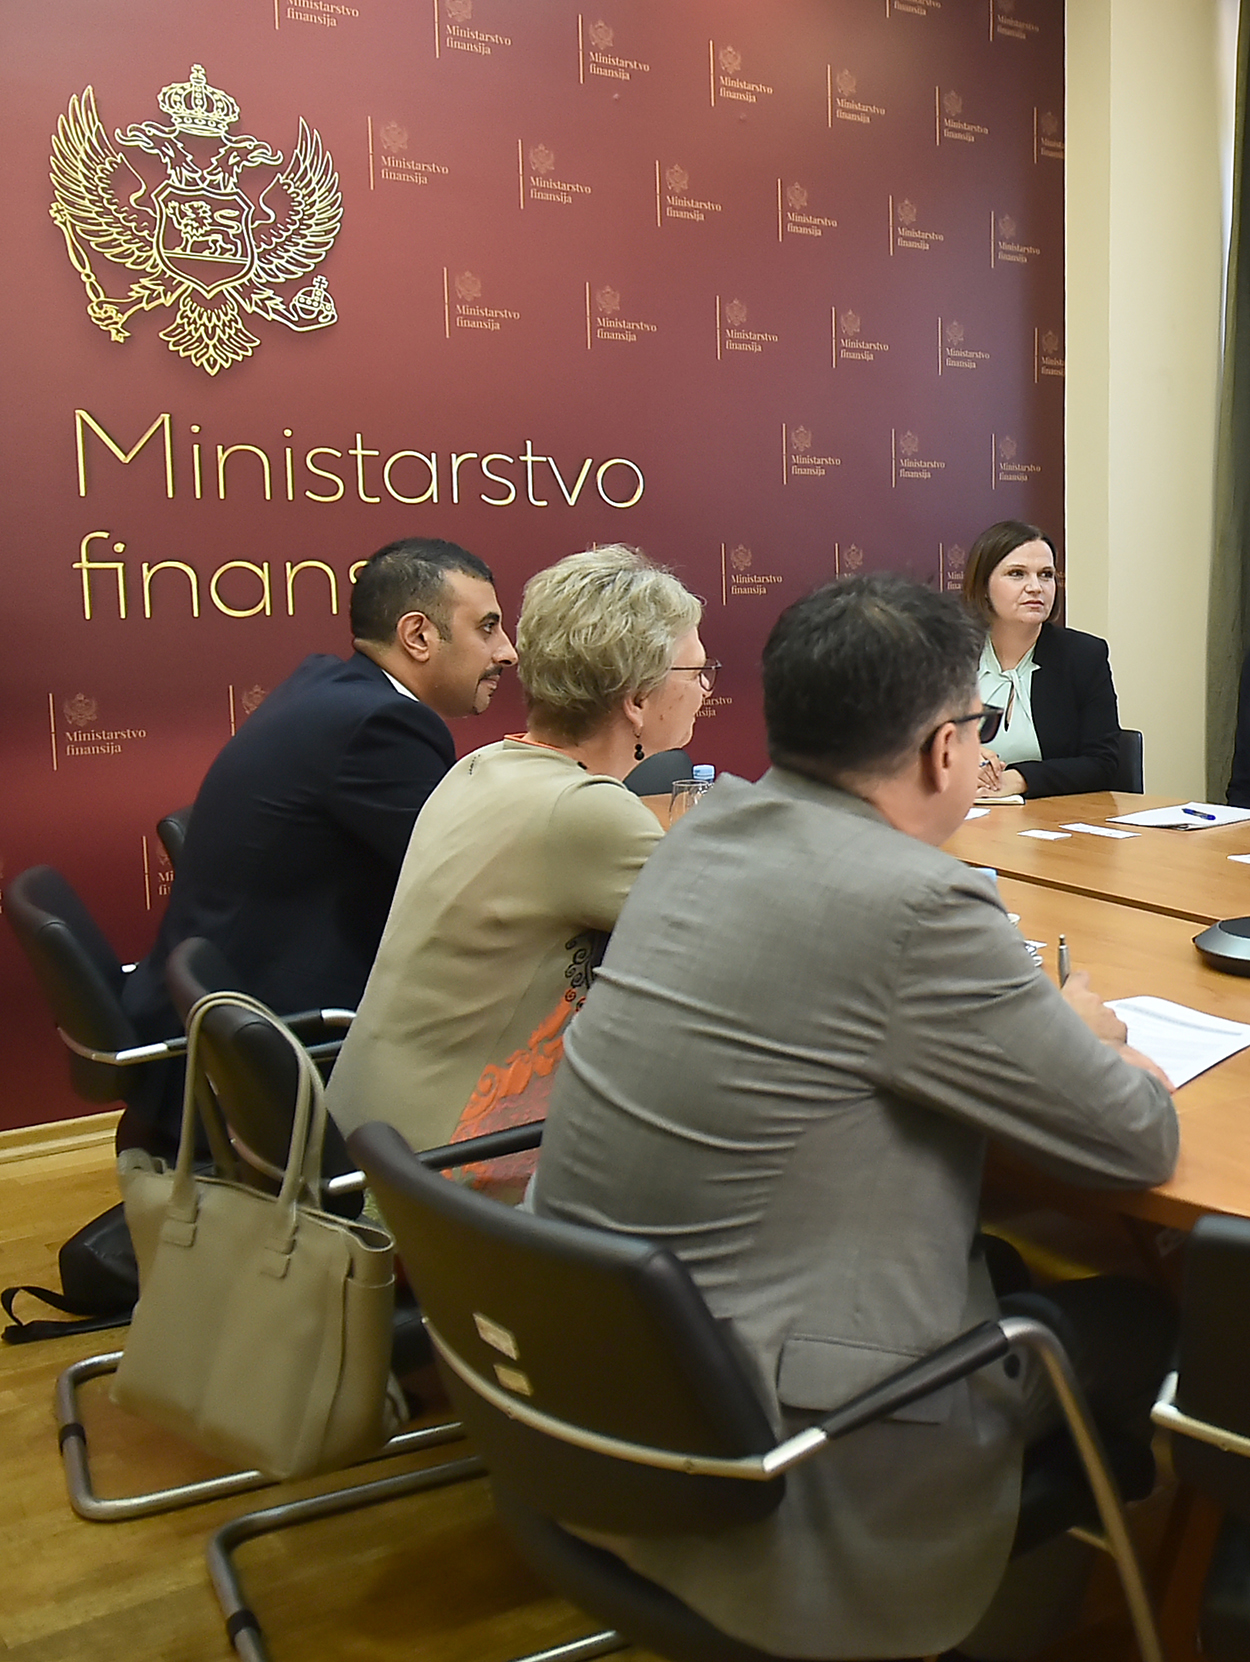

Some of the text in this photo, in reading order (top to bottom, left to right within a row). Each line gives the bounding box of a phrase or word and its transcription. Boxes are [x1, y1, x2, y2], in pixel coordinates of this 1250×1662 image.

[287, 8, 337, 27] finansija
[446, 25, 511, 46] Ministarstvo
[446, 37, 491, 54] finansija
[590, 52, 649, 72] Ministarstvo
[590, 64, 630, 81] finansija
[720, 76, 773, 95] Ministarstvo
[720, 88, 756, 103] finansija
[836, 99, 885, 115] Ministarstvo
[836, 109, 871, 124] finansija
[381, 156, 449, 174] Ministarstvo
[381, 168, 428, 184] finansija
[530, 176, 591, 194] Ministarstvo
[530, 188, 572, 203] finansija
[666, 196, 721, 211] Ministarstvo
[666, 208, 704, 221] finansija
[787, 213, 837, 227] Ministarstvo
[787, 223, 822, 236] finansija
[898, 228, 943, 242] Ministarstvo
[898, 238, 929, 250] finansija
[456, 305, 520, 320] Ministarstvo
[456, 316, 500, 330] finansija
[596, 317, 657, 332] Ministarstvo
[596, 329, 636, 342] finansija
[726, 330, 778, 343] Ministarstvo
[726, 340, 761, 352] finansija
[841, 340, 889, 351] Ministarstvo
[841, 350, 873, 361] finansija
[946, 349, 990, 360] Ministarstvo
[946, 358, 976, 369] finansija
[74, 408, 645, 508] Ministarstvo
[792, 455, 841, 466] Ministarstvo
[900, 459, 945, 469] Ministarstvo
[792, 466, 825, 476] finansija
[900, 469, 931, 478] finansija
[999, 462, 1040, 472] Ministarstvo
[72, 531, 370, 620] finan
[731, 574, 782, 584] Ministarstvo
[731, 585, 766, 595] finansija
[66, 728, 147, 741] Ministarstvo
[66, 741, 122, 756] finansija
